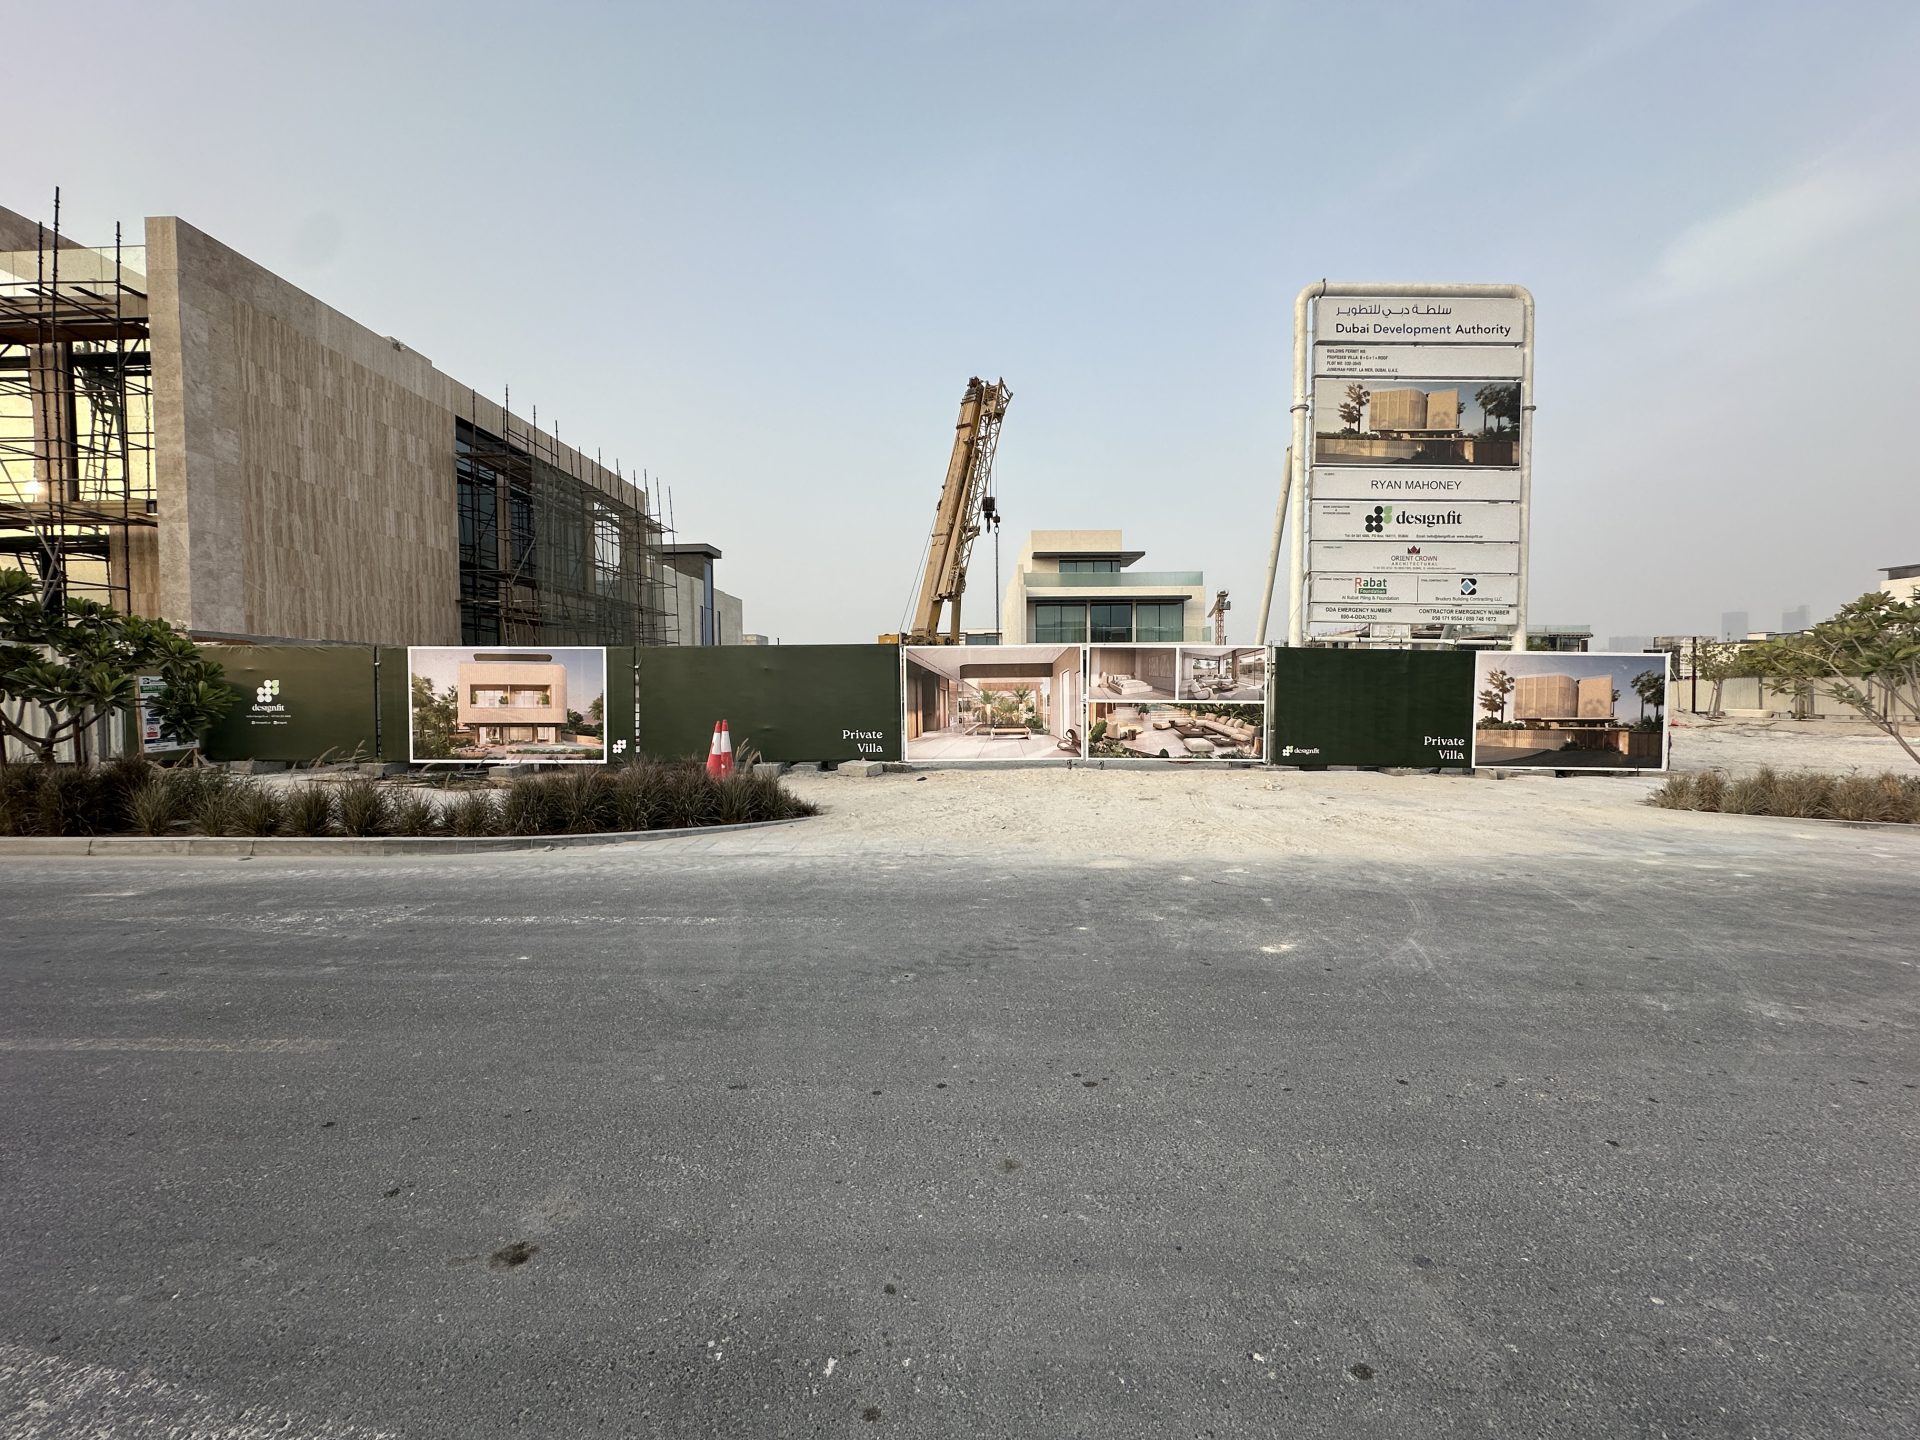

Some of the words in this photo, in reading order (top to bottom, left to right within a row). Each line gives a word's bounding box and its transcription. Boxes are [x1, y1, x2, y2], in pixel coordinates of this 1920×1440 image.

[1336, 304, 1380, 316] للتطوير
[1382, 307, 1410, 318] دبي
[1336, 323, 1370, 334] Dubai
[1373, 324, 1452, 336] Development
[1455, 324, 1511, 338] Authority
[1371, 480, 1401, 489] RYAN
[1405, 480, 1462, 490] MAHONEY
[1396, 510, 1462, 528] designfit
[1355, 577, 1387, 588] Rabat
[252, 704, 285, 713] designfit
[842, 730, 883, 739] Private
[1424, 736, 1465, 745] Private
[857, 743, 883, 752] Villa
[1439, 750, 1464, 759] Villa
